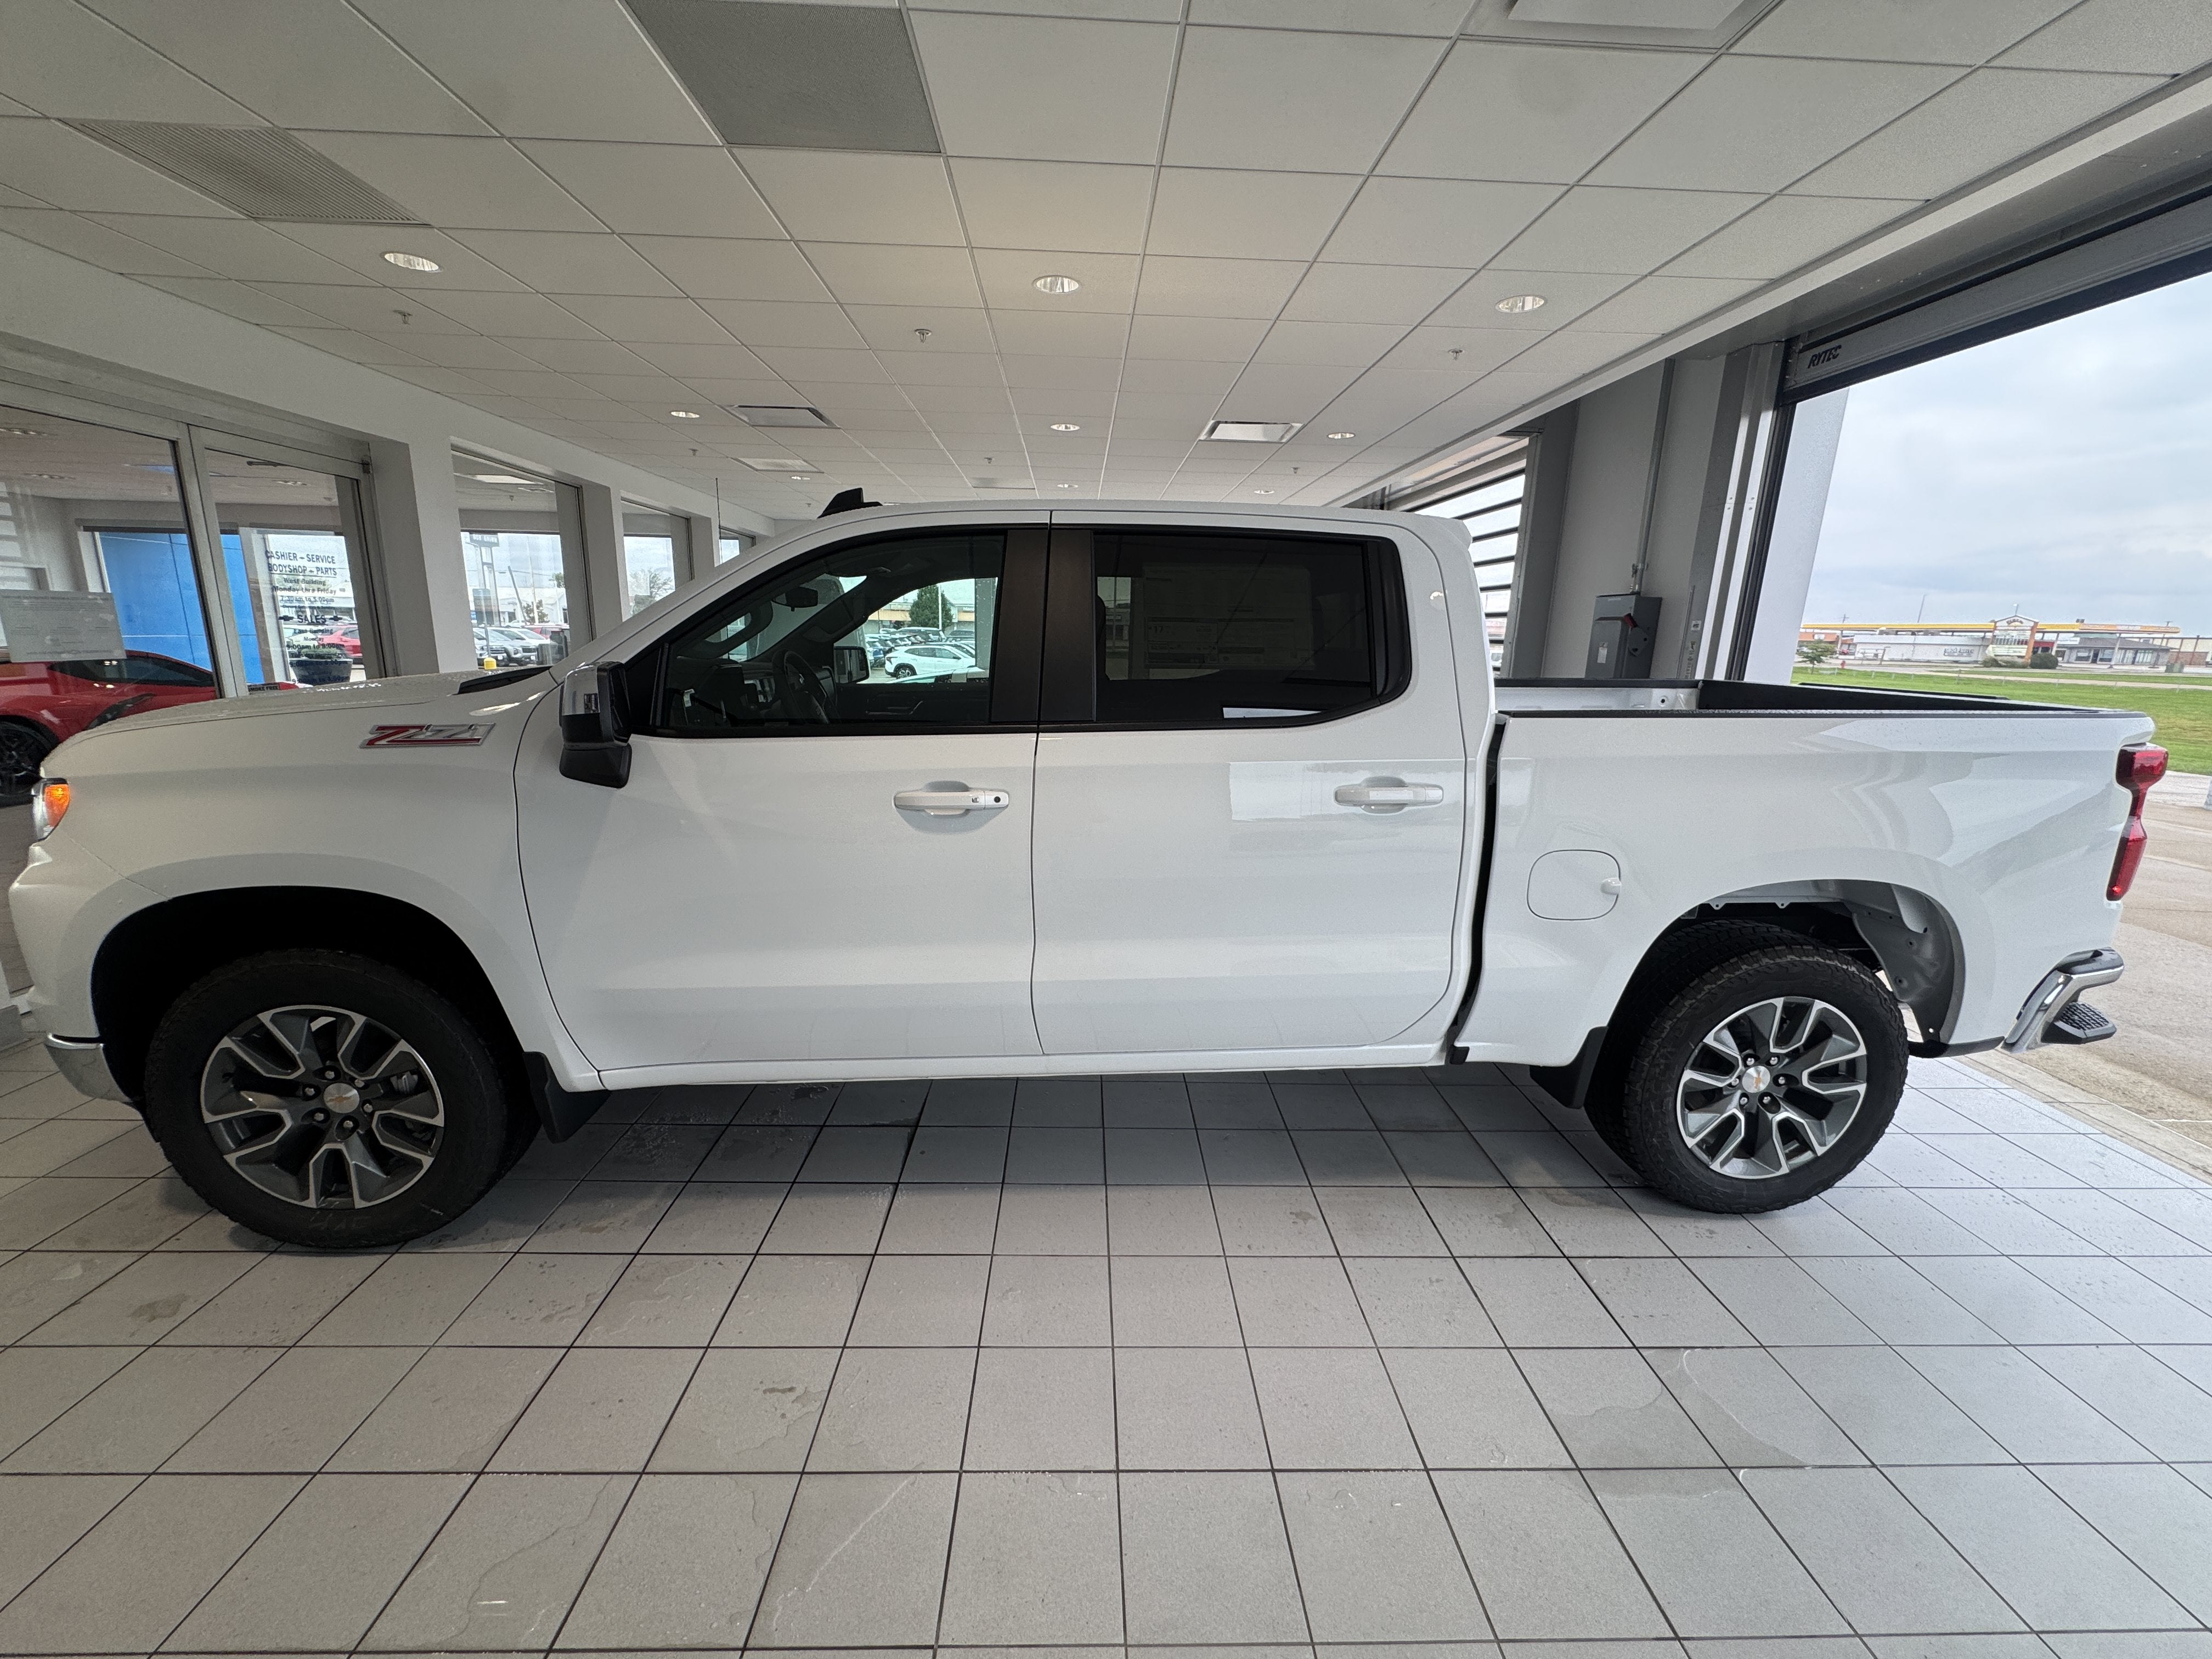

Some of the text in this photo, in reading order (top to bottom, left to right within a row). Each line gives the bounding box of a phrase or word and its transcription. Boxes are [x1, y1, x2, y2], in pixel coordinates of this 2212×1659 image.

[1807, 345, 1842, 369] RYTEC
[266, 550, 336, 564] CASHIER SERVICE
[268, 563, 337, 575] BODYSHOP PARTS
[273, 585, 300, 594] Monday
[297, 614, 326, 623] SALES
[360, 723, 496, 749] Z71
